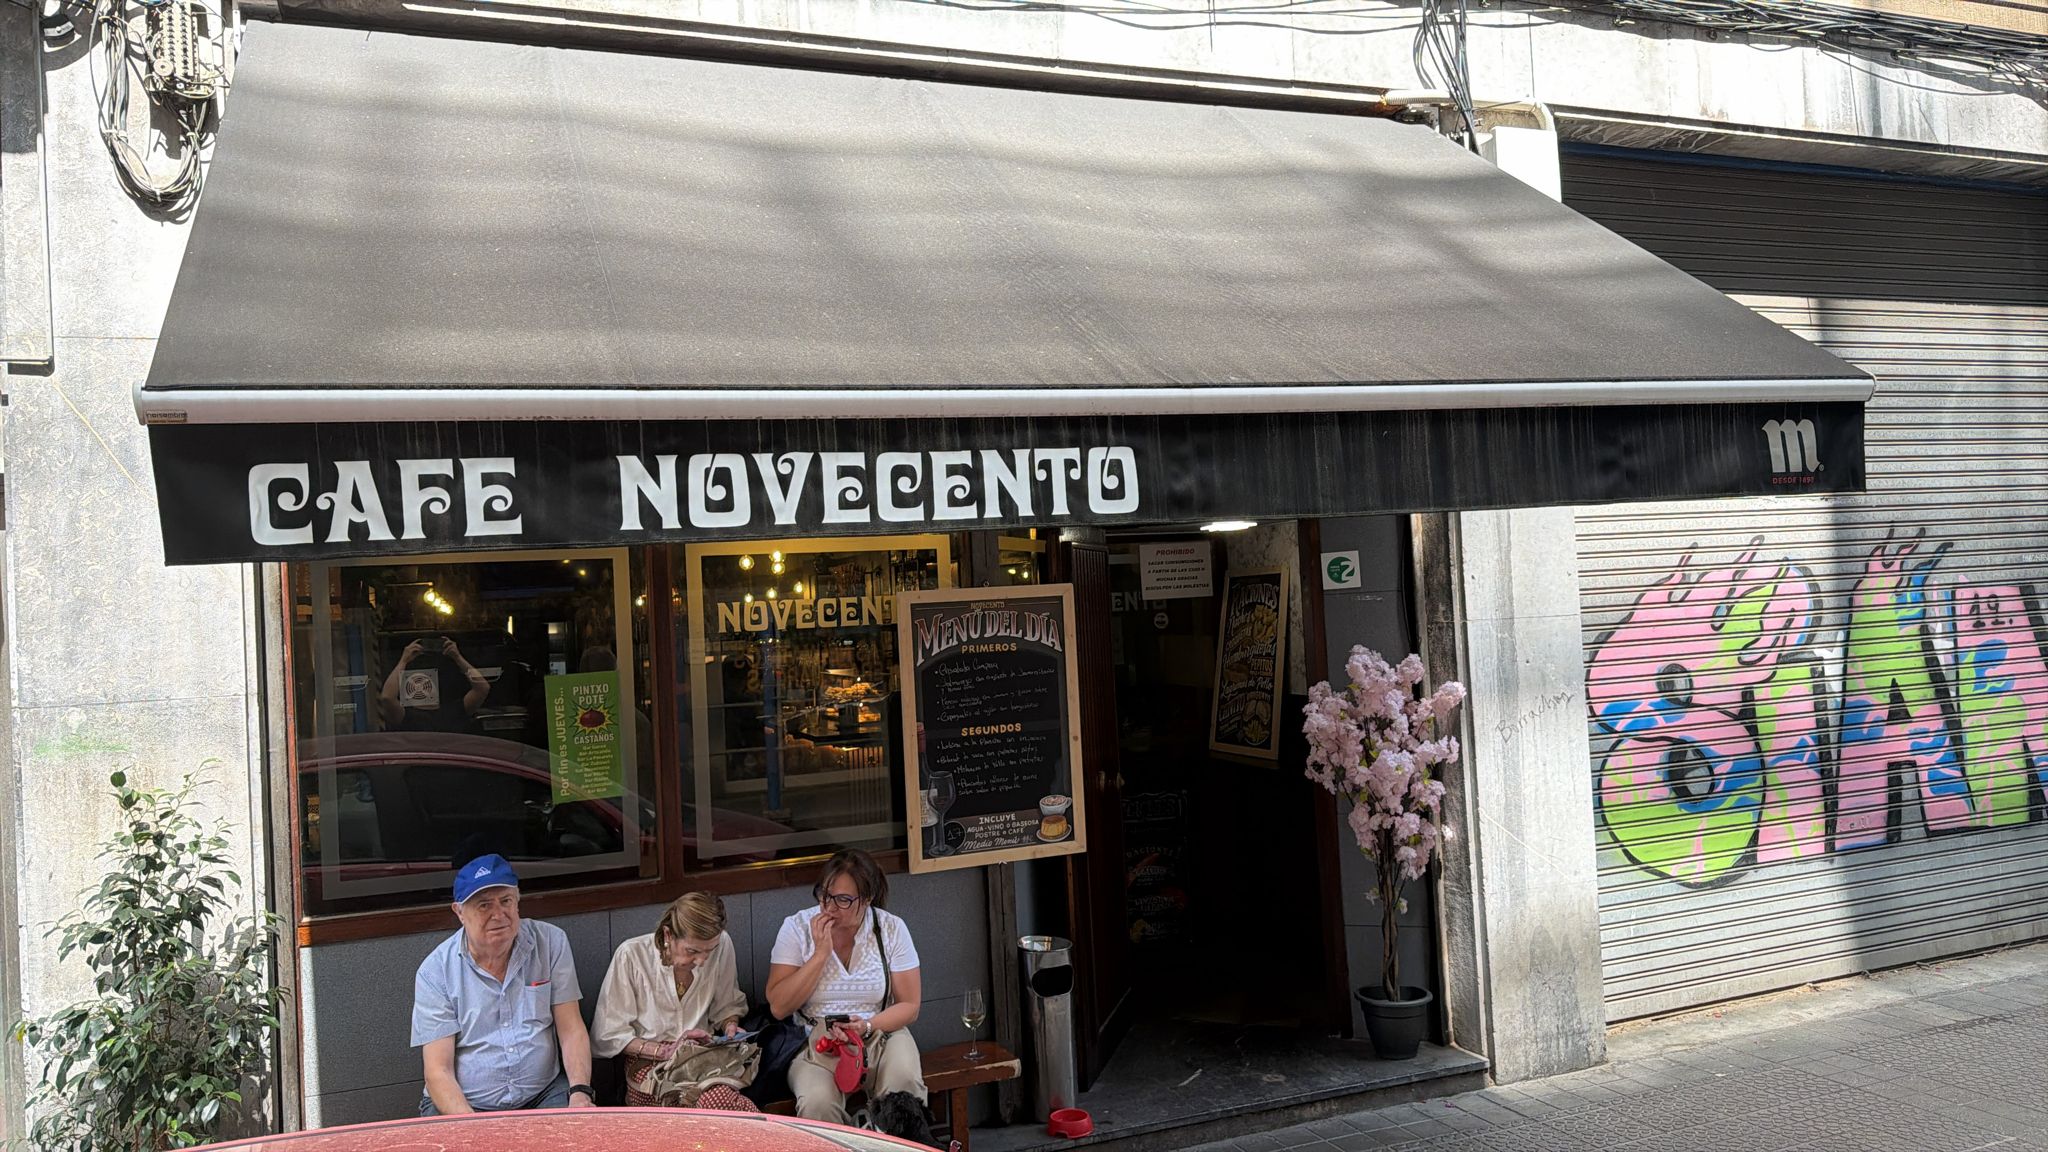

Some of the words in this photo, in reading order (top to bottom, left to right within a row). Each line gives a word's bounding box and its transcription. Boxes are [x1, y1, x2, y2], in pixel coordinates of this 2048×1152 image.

[248, 457, 523, 546] CAFE
[616, 446, 1140, 531] NOVECENTO
[1156, 548, 1195, 556] PROHIBIDO
[717, 596, 898, 633] NOVECENT
[984, 610, 1022, 637] DEL
[1024, 611, 1063, 652] DÍA
[961, 642, 1018, 654] PRIMEROS
[572, 683, 609, 696] PINTXO
[578, 694, 605, 705] POTE
[961, 722, 1023, 737] SEGUNDOS
[574, 731, 615, 745] CASTAÑOS
[558, 757, 569, 774] fin
[560, 776, 570, 797] Por
[978, 813, 1017, 825] INCLUYE
[974, 831, 1001, 839] POSTRE
